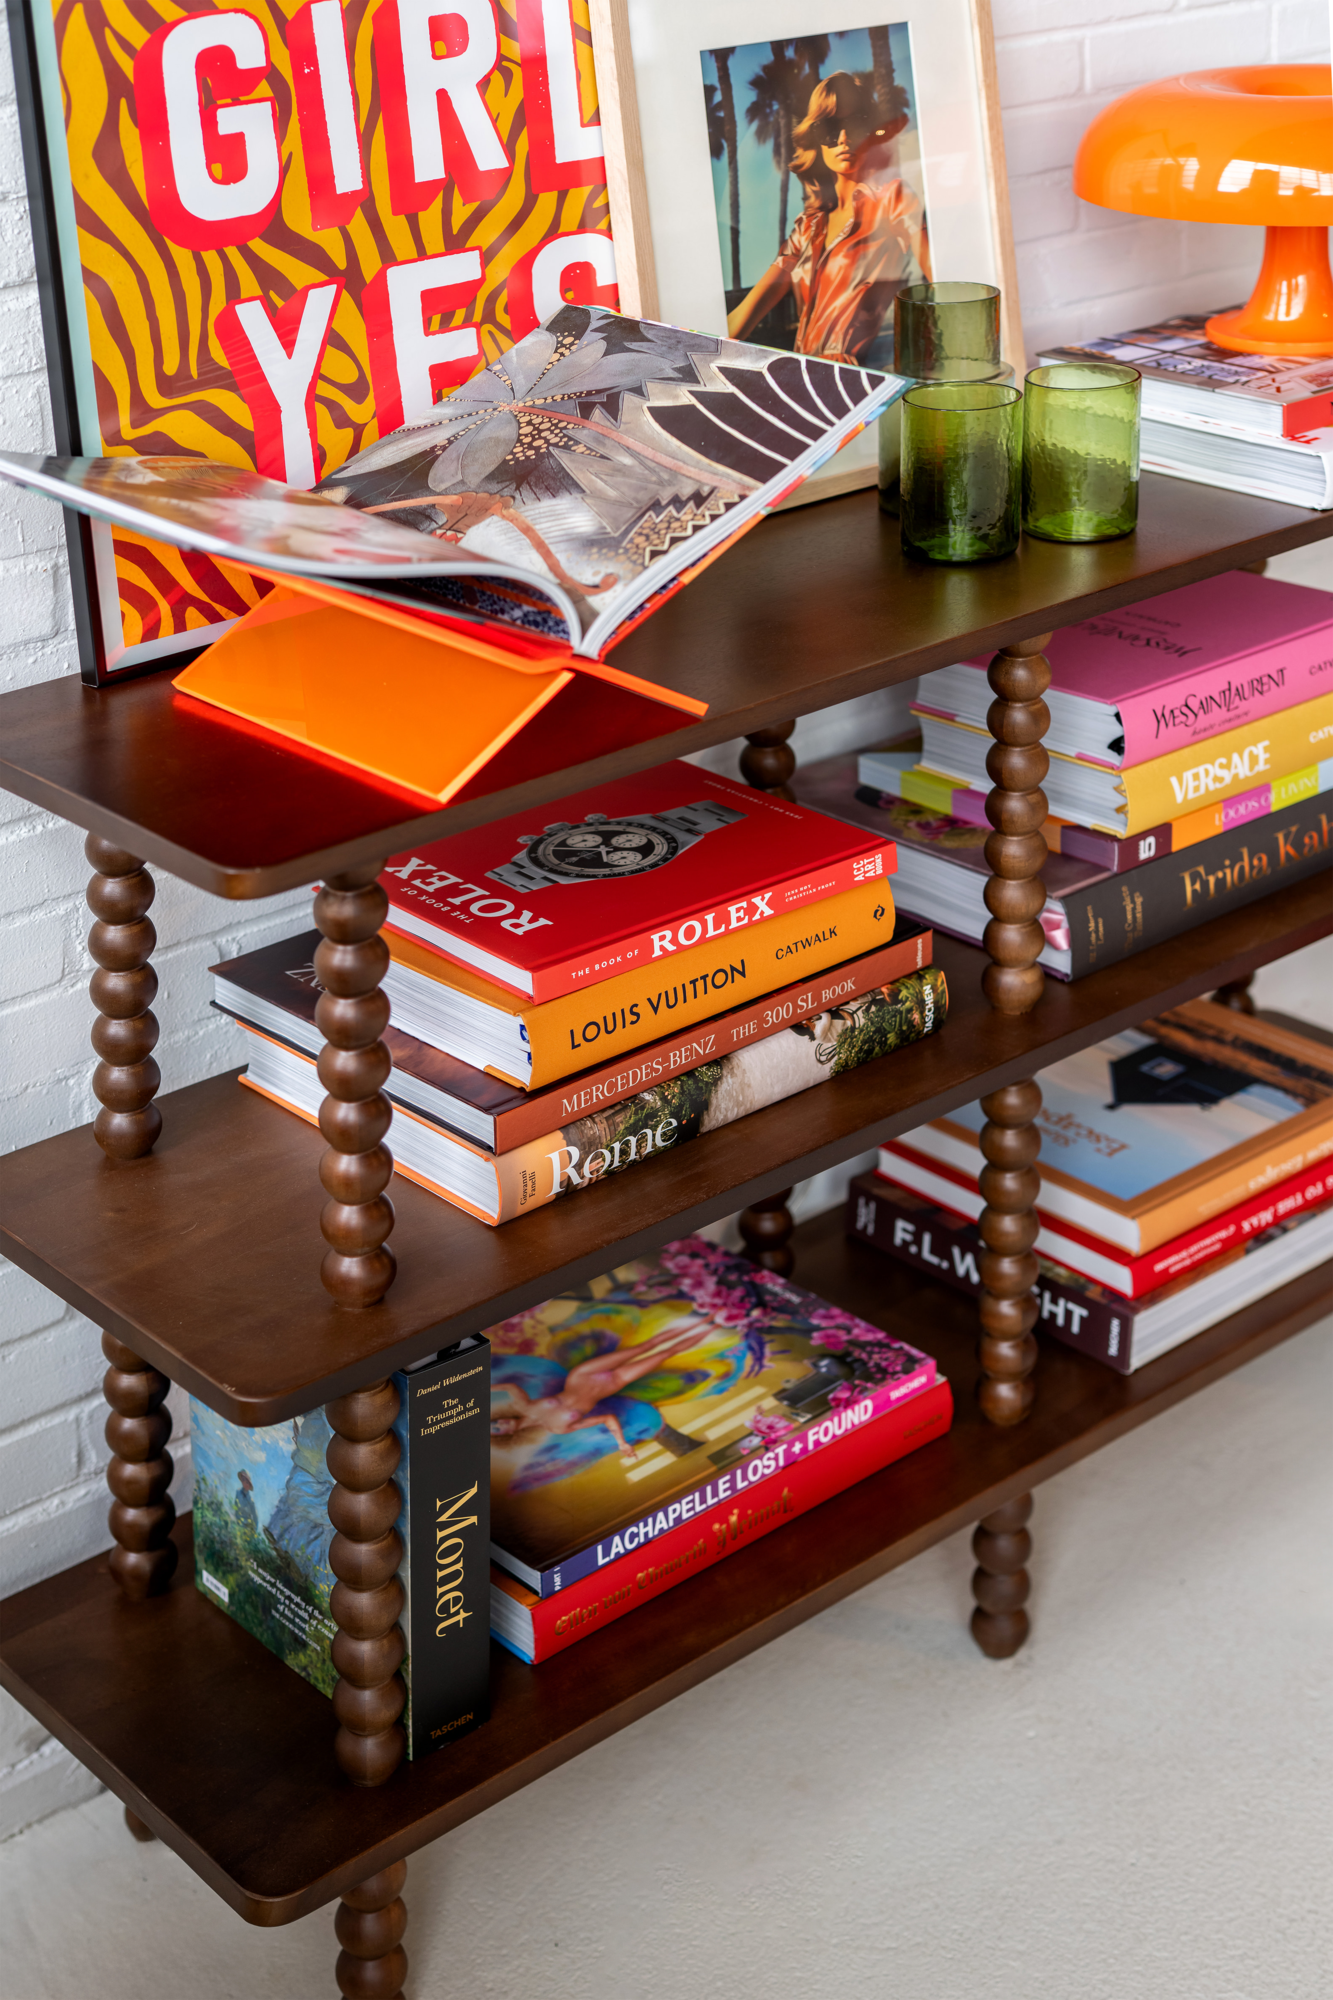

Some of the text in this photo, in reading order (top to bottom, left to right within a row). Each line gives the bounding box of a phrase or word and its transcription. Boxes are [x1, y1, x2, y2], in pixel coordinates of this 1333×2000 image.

[160, 0, 606, 223] GIRL
[1169, 740, 1271, 804] VERSACE
[853, 860, 865, 881] ACC
[864, 857, 876, 877] ART
[875, 853, 884, 875] BOOKS
[1179, 846, 1272, 911] Frida
[384, 856, 554, 936] ROLEX
[400, 887, 475, 924] THE BOOK OF
[785, 880, 836, 903] CHRISTIAN FROST
[785, 887, 799, 898] JENS
[650, 891, 775, 959] ROLEX
[775, 925, 838, 960] CATWALK
[571, 949, 640, 979] THE BOOK OF
[569, 958, 747, 1050] LOUIS VUITTON
[923, 984, 935, 1034] TASCHEN
[561, 977, 857, 1117] MERCEDES-BENZ THE 300 SL BOOK
[545, 1118, 678, 1198] Rome
[519, 1169, 527, 1206] Giovanni
[528, 1171, 536, 1198] Fanelli
[416, 1366, 483, 1398] Daniel Wildenstein
[426, 1398, 475, 1425] Triumph of
[442, 1397, 459, 1409] The
[420, 1407, 480, 1436] Impressionism
[596, 1398, 875, 1567] LACHAPELLE LOST + FOUND
[435, 1480, 478, 1638] Monet
[553, 1573, 562, 1591] PART
[554, 1602, 599, 1637] Ellen
[602, 1584, 632, 1610] von
[430, 1712, 474, 1739] TASCHEN
